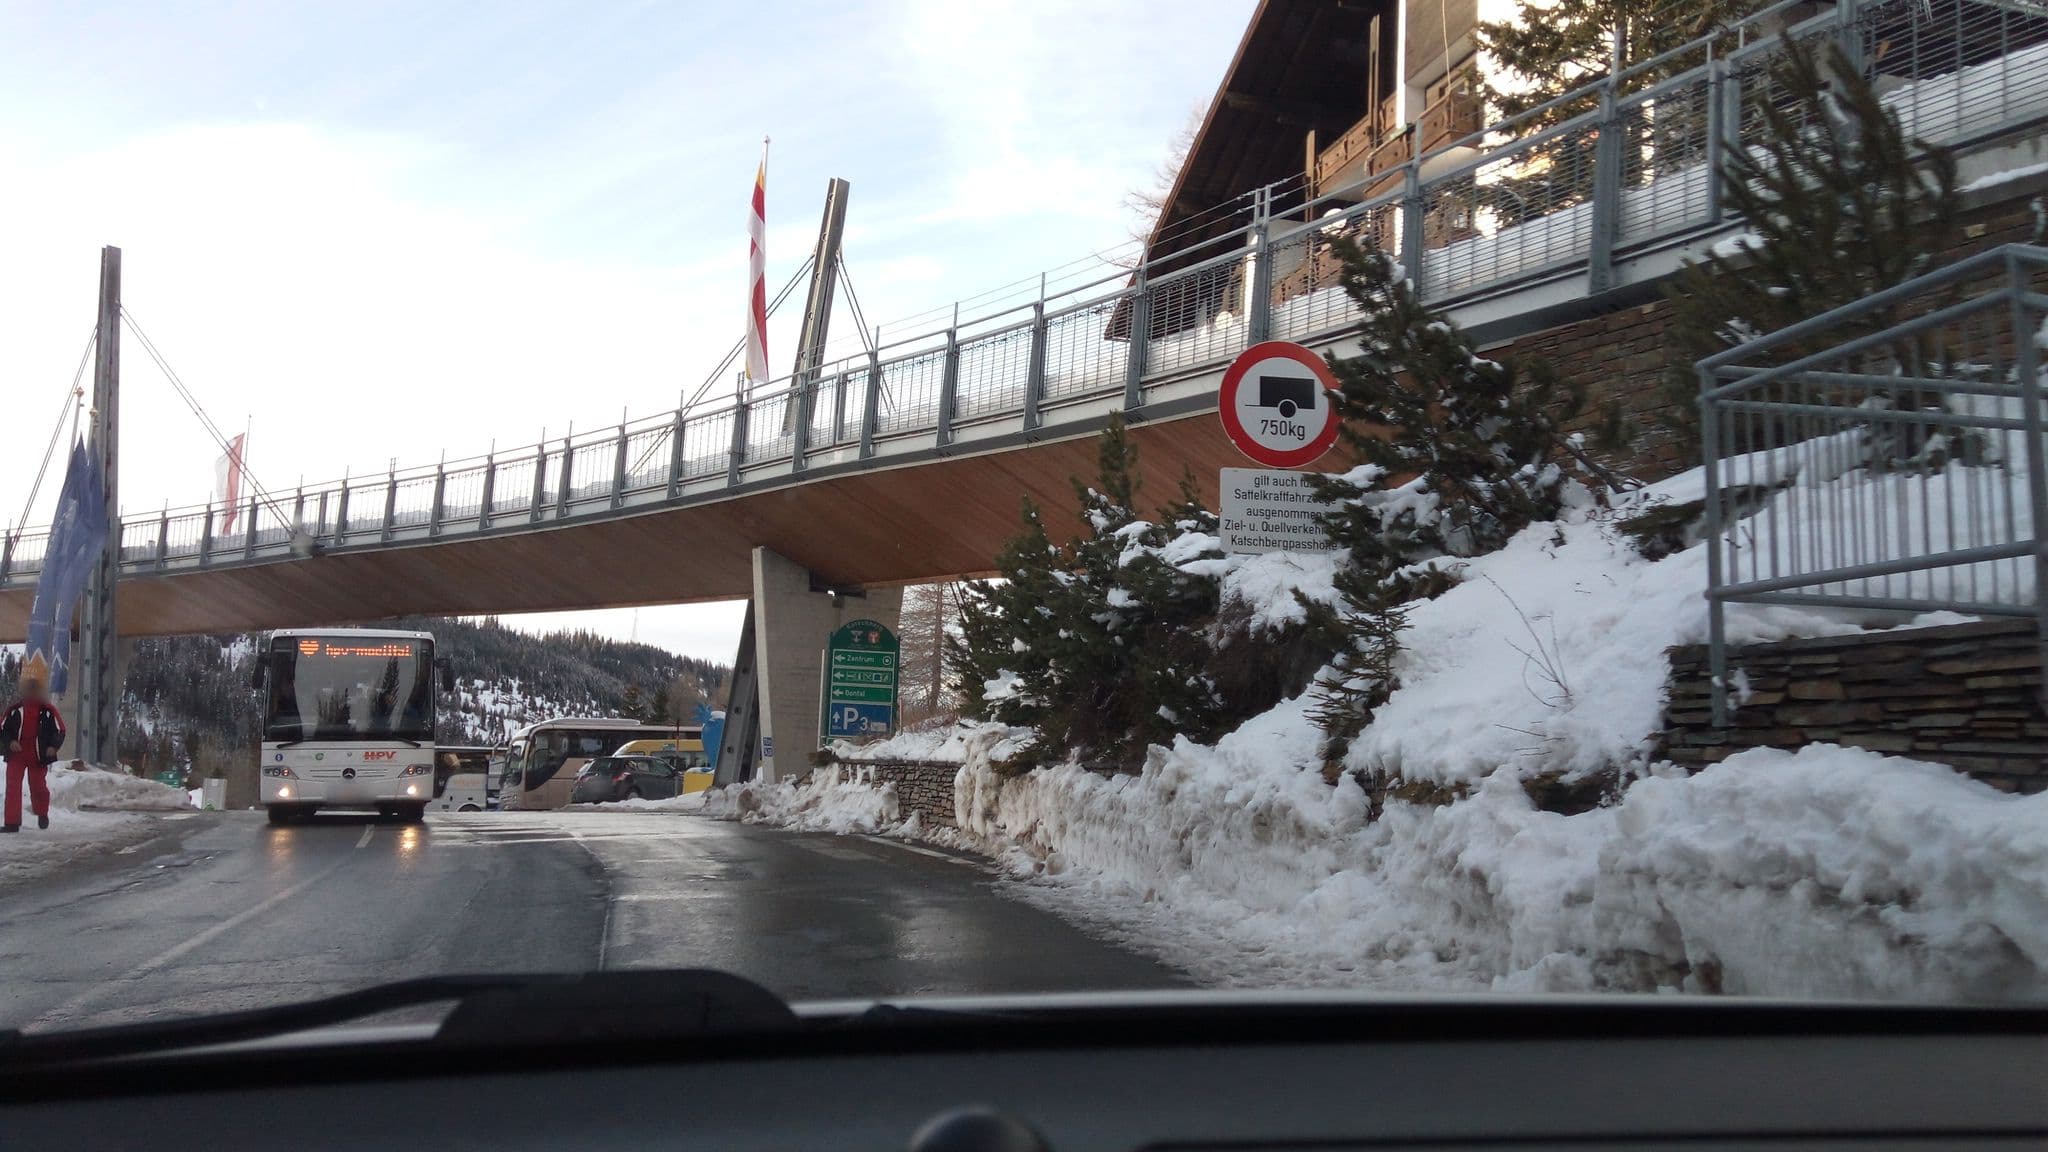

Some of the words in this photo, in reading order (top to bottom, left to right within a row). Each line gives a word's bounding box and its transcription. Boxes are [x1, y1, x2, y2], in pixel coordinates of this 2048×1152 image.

[1260, 419, 1305, 441] 750kg
[1254, 476, 1270, 487] gilt
[1272, 476, 1297, 487] auch
[1246, 506, 1322, 520] ausgenommen
[1224, 519, 1246, 531] Ziel-
[847, 654, 875, 663] Zentrum
